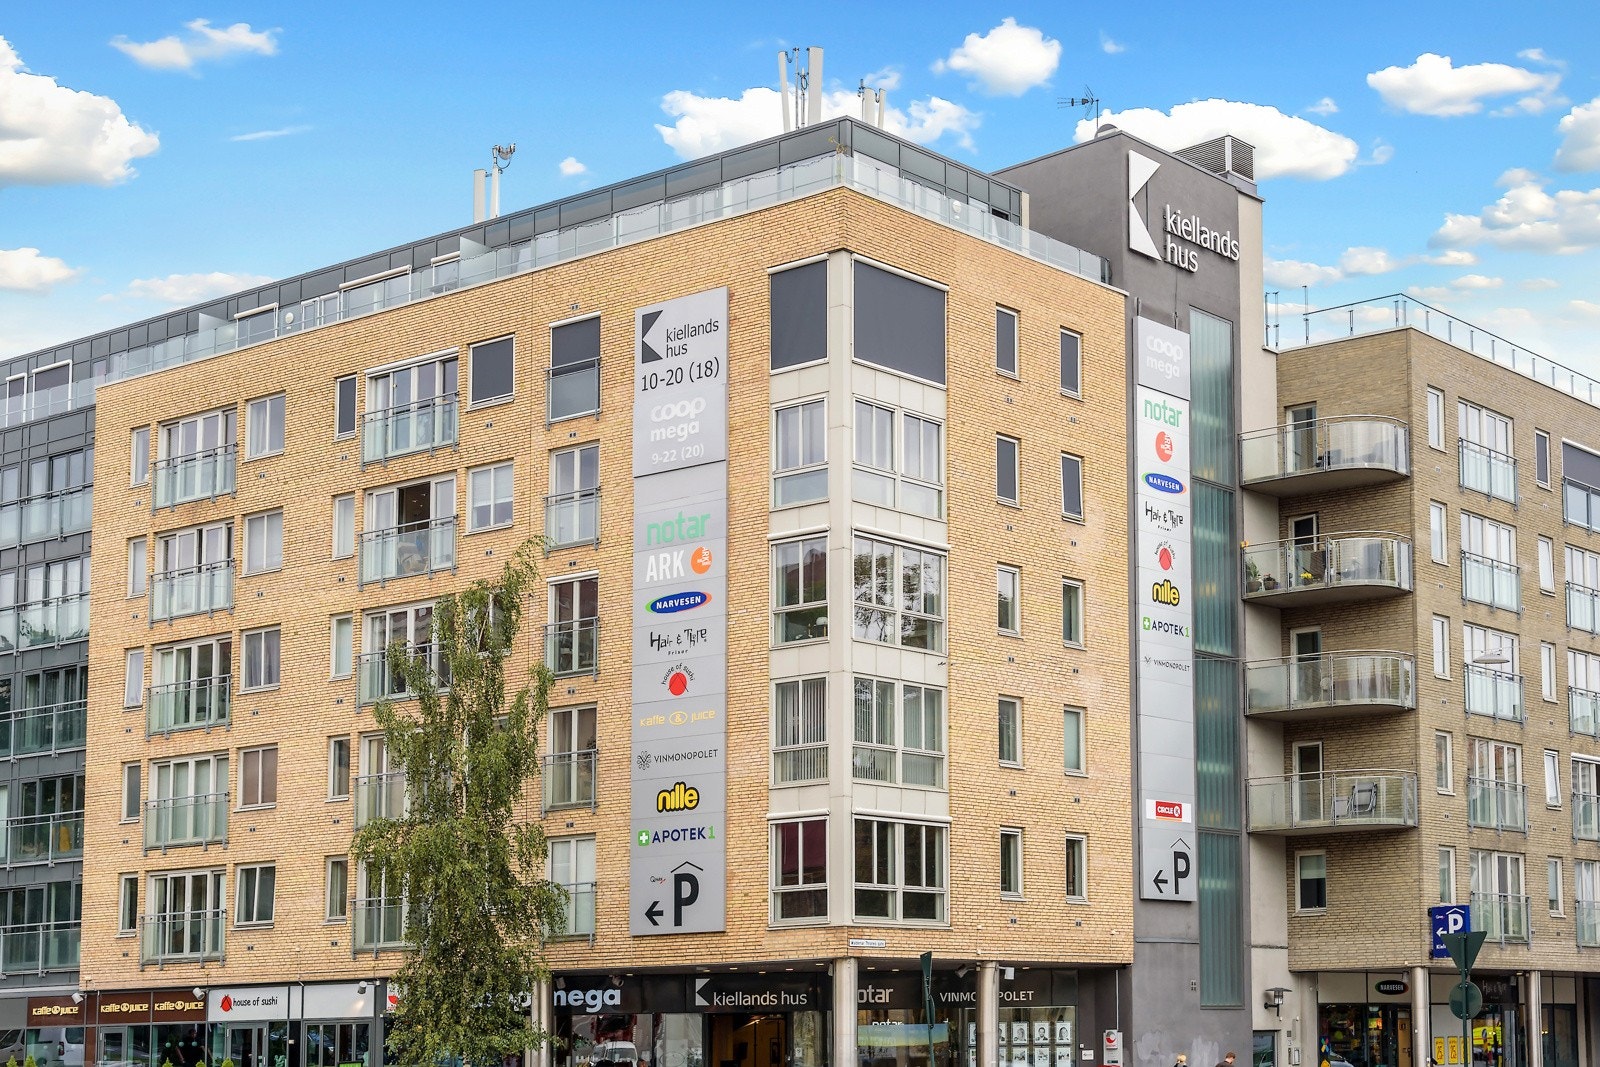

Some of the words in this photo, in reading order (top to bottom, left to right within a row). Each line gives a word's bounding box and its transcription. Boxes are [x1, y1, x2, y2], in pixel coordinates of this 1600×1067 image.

[1166, 204, 1240, 261] kiellands
[1166, 234, 1198, 273] hus
[666, 318, 719, 343] kiellands
[666, 343, 688, 359] hus
[1146, 335, 1184, 363] coop
[641, 367, 684, 392] 10-20
[689, 356, 720, 383] (18)
[1146, 355, 1180, 379] mega
[650, 397, 707, 423] coop
[1144, 399, 1183, 428] notar
[650, 420, 700, 443] mega
[651, 450, 677, 465] 9-22
[681, 443, 705, 461] (20)
[1149, 476, 1180, 491] NARVESEN
[646, 510, 711, 545] notar
[645, 549, 685, 583] ARK
[656, 595, 702, 610] NARVESEN
[1152, 579, 1180, 607] nille
[650, 631, 673, 651] Hair
[661, 666, 675, 685] house
[654, 749, 718, 764] VINMONOPOLET
[656, 781, 700, 813] nille
[1173, 851, 1191, 894] P
[674, 872, 700, 927] P
[1448, 913, 1464, 934] P
[233, 997, 251, 1006] house
[253, 997, 260, 1006] of
[261, 996, 278, 1006] sushi
[713, 991, 778, 1006] kiellands
[781, 991, 808, 1005] hus
[857, 985, 894, 1003] otar
